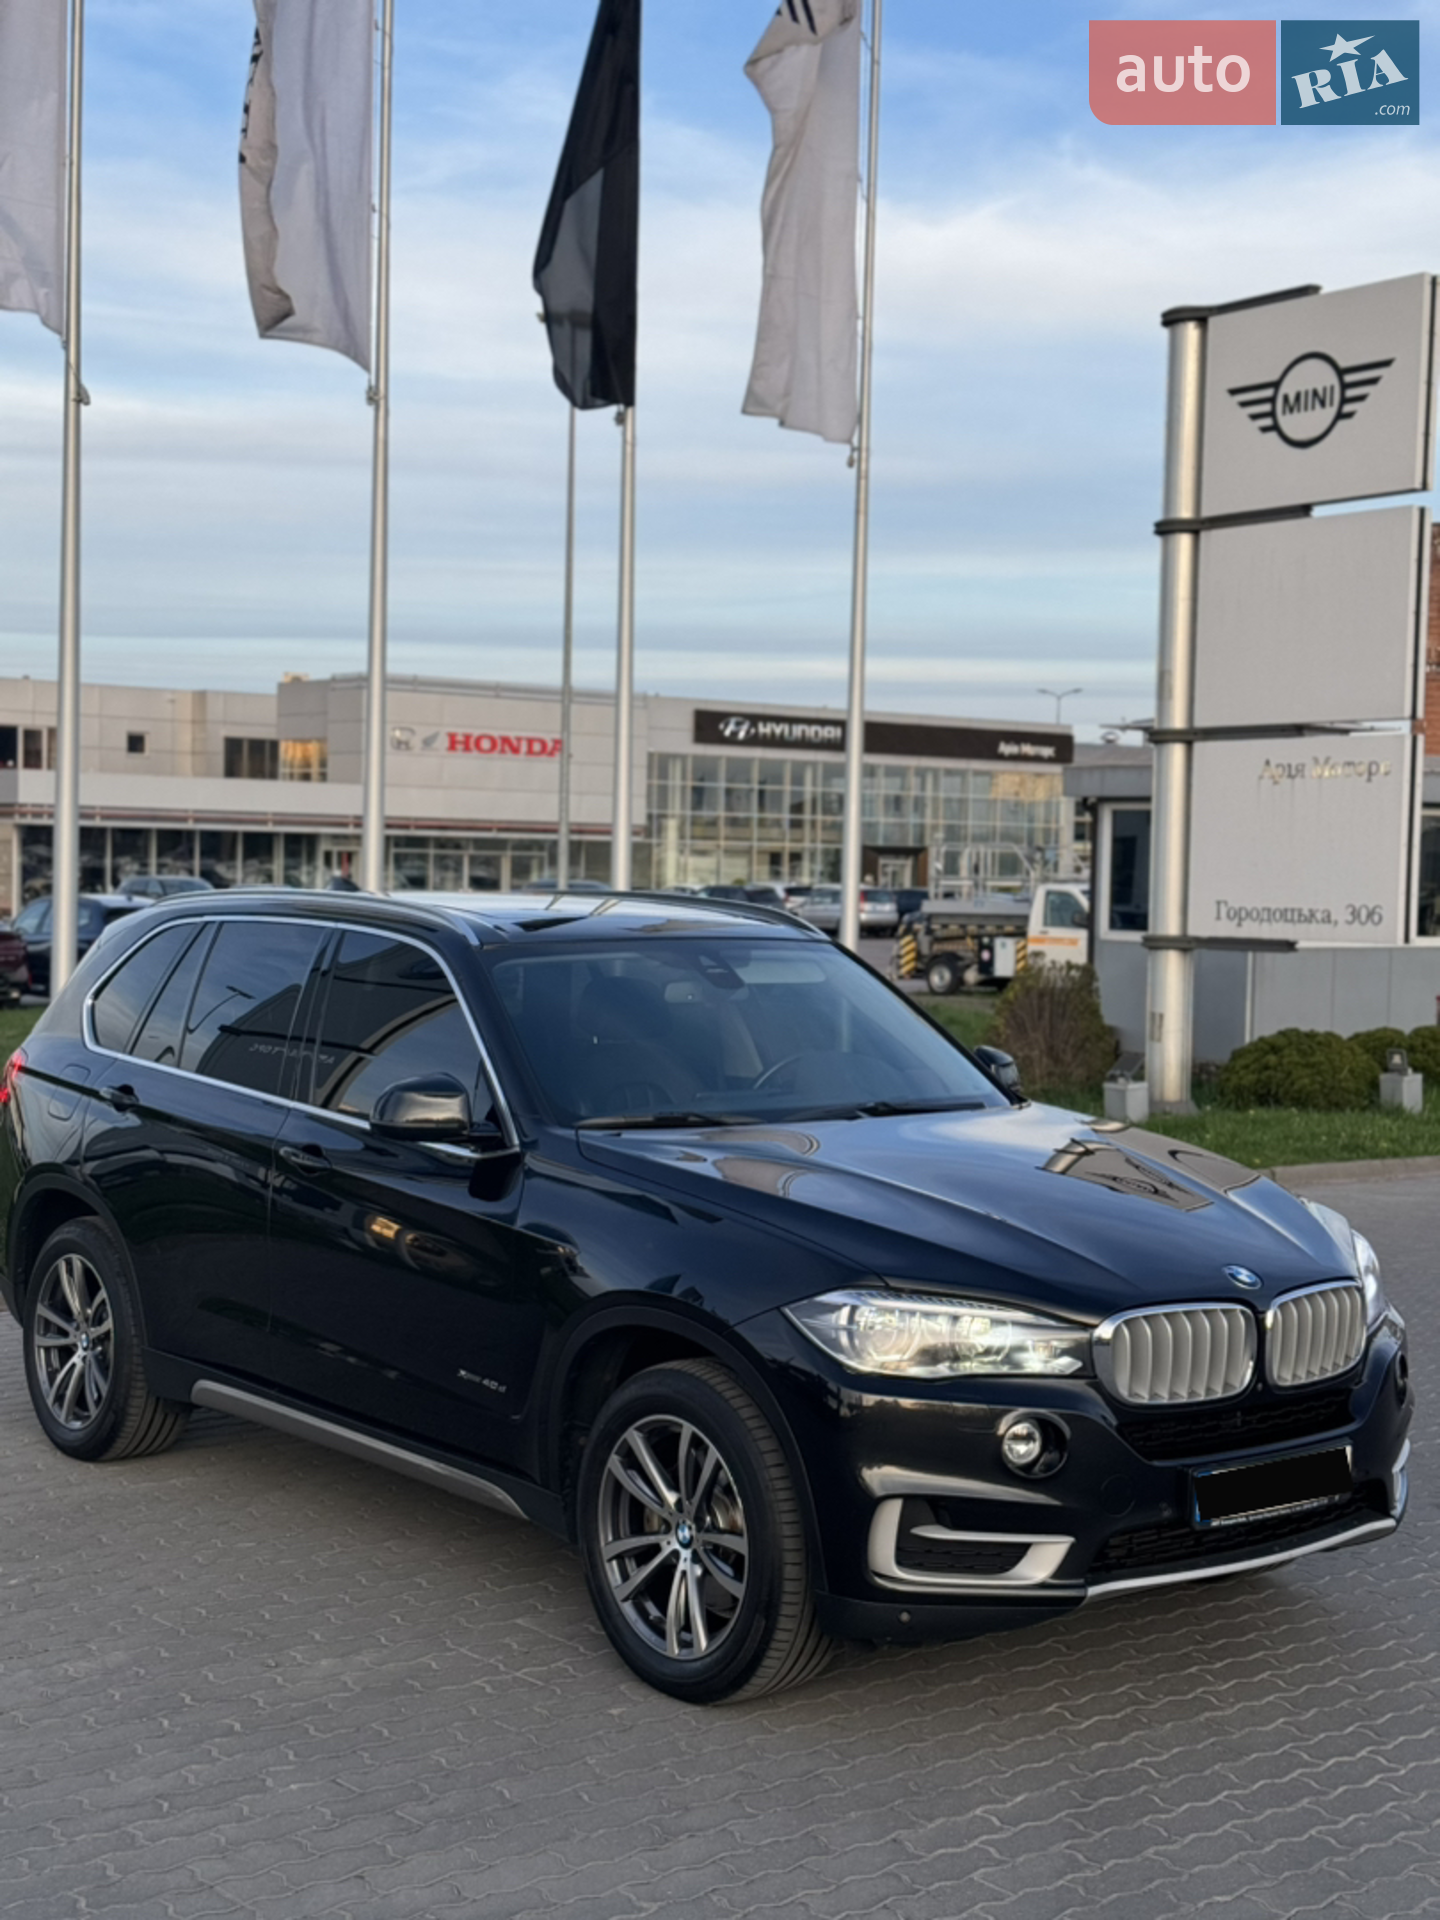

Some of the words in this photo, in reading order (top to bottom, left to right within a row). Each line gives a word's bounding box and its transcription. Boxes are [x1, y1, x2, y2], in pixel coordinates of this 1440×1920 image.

[1281, 384, 1335, 416] MINI
[757, 721, 842, 743] HYUNDAI
[1214, 900, 1338, 927] Городоцька,
[1344, 903, 1383, 926] 306
